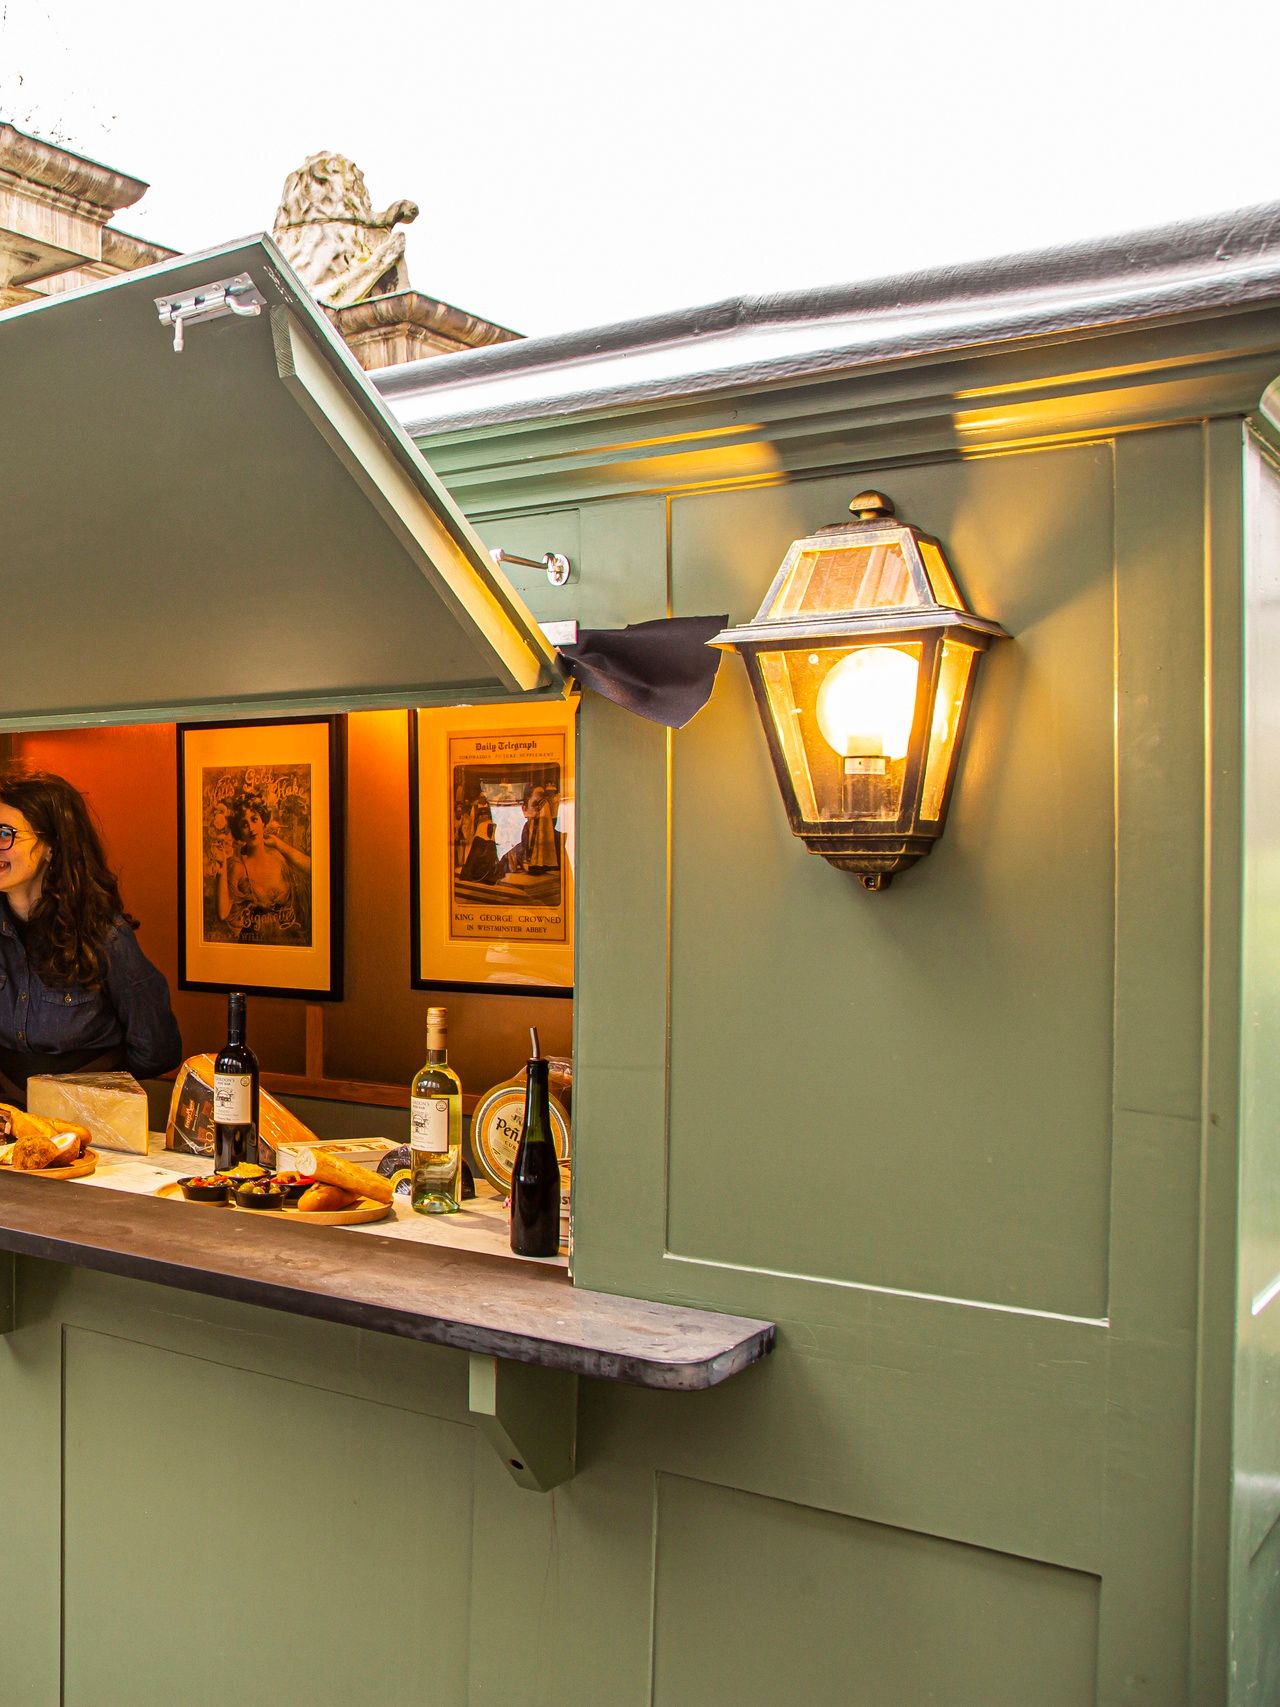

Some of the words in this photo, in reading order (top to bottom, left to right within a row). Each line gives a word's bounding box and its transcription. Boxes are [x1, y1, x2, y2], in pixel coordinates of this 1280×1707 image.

[475, 743, 497, 752] Daily
[498, 741, 537, 750] Telegraph
[454, 913, 474, 921] KING
[479, 914, 513, 923] GEORGE
[518, 915, 562, 924] CROWNED
[477, 924, 522, 933] WESTMINSTER
[525, 926, 548, 934] ABBEY
[504, 1140, 518, 1151] CUR
